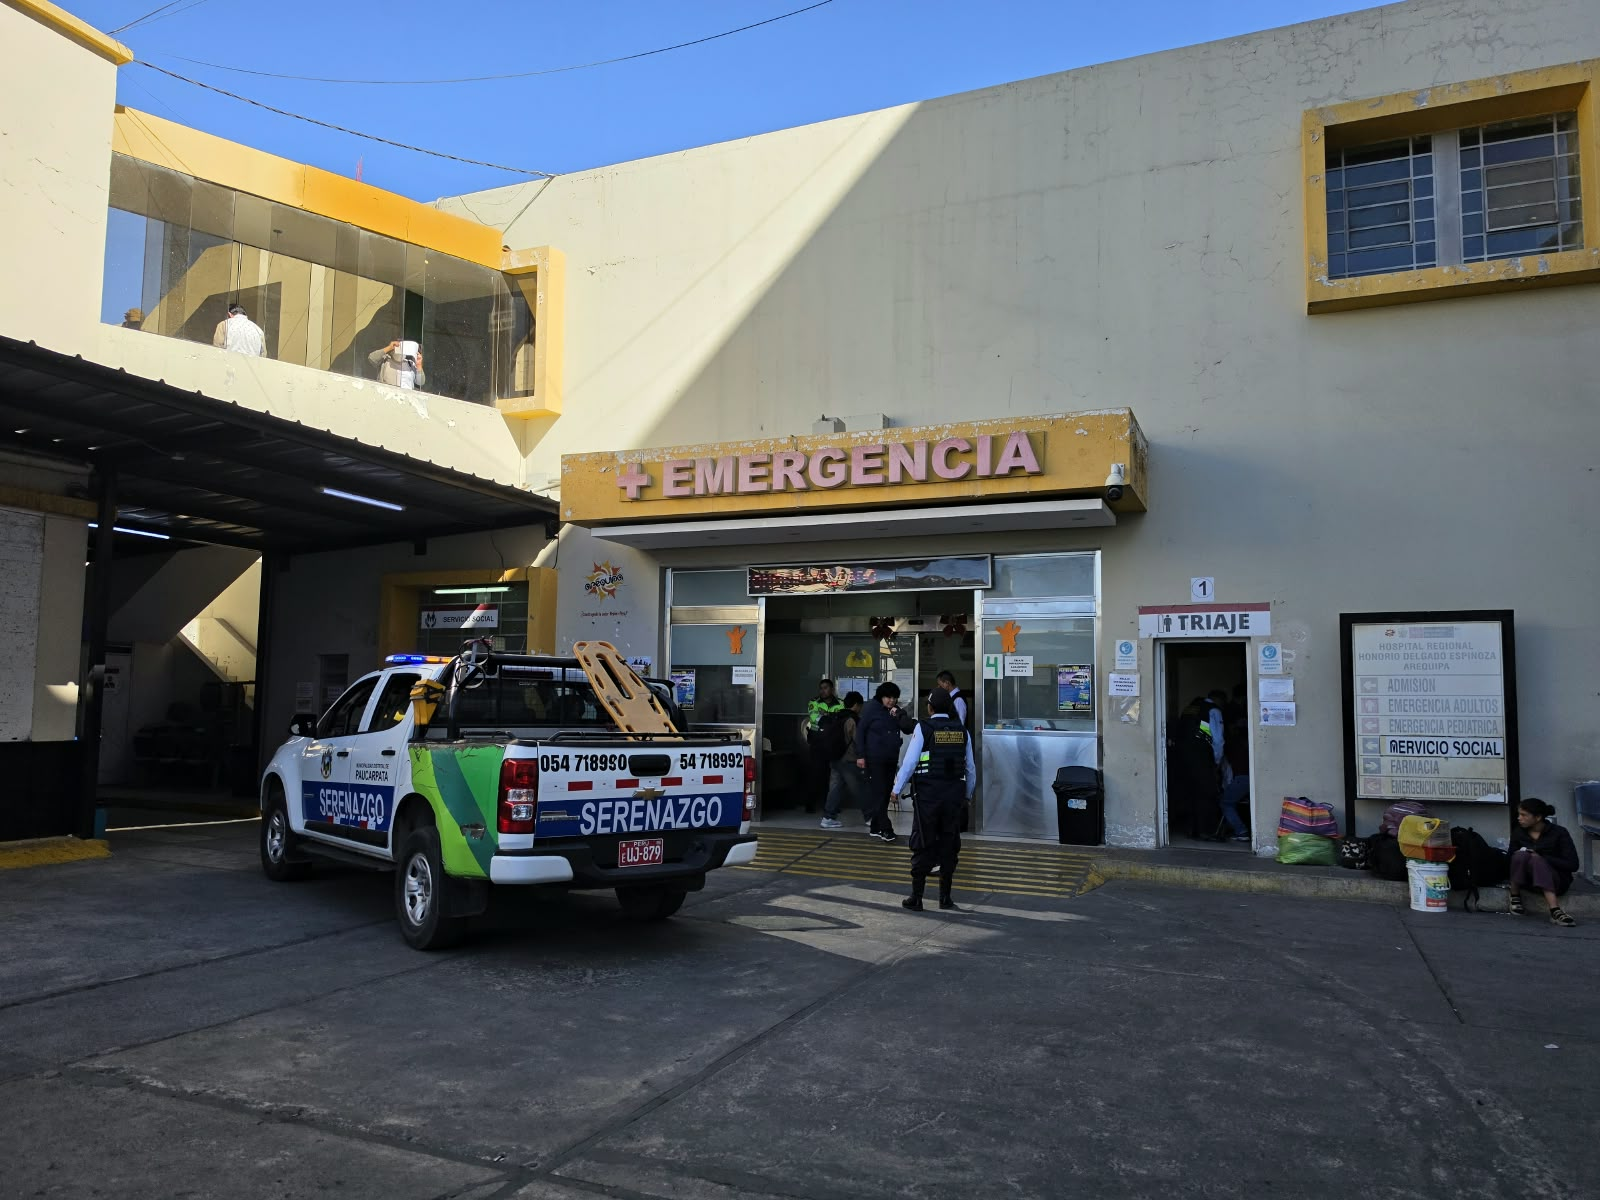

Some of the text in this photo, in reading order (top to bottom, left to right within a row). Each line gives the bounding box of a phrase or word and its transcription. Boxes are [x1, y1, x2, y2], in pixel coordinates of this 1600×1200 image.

[663, 431, 1042, 497] EMERGENCIA
[1198, 580, 1207, 596] 1
[443, 615, 471, 623] SERVICIO
[1177, 613, 1250, 634] TRIAJE
[1379, 641, 1474, 651] HOSPITAL REGIONAL
[1358, 651, 1497, 661] HONORIO DELGADO ESPINOZA
[985, 655, 998, 678] 4
[1403, 662, 1450, 671] AREQUIPA
[1387, 678, 1436, 693] ADMISION
[1388, 698, 1498, 714] EMERGENCIA ADULTOS
[1389, 718, 1498, 735] EMERGENCIA PEDIATRICA
[1453, 741, 1501, 756] SOCIAL
[540, 754, 569, 772] 054
[680, 752, 743, 770] 54 718992
[1390, 759, 1440, 775] FARMACIA
[355, 769, 389, 782] PAUCARPATA
[1391, 779, 1437, 795] EMERGENCIA
[320, 788, 384, 825] SERENAZGO
[580, 796, 722, 836] SERENAZGO
[633, 840, 650, 848] PERU
[626, 845, 661, 863] UJ-879
